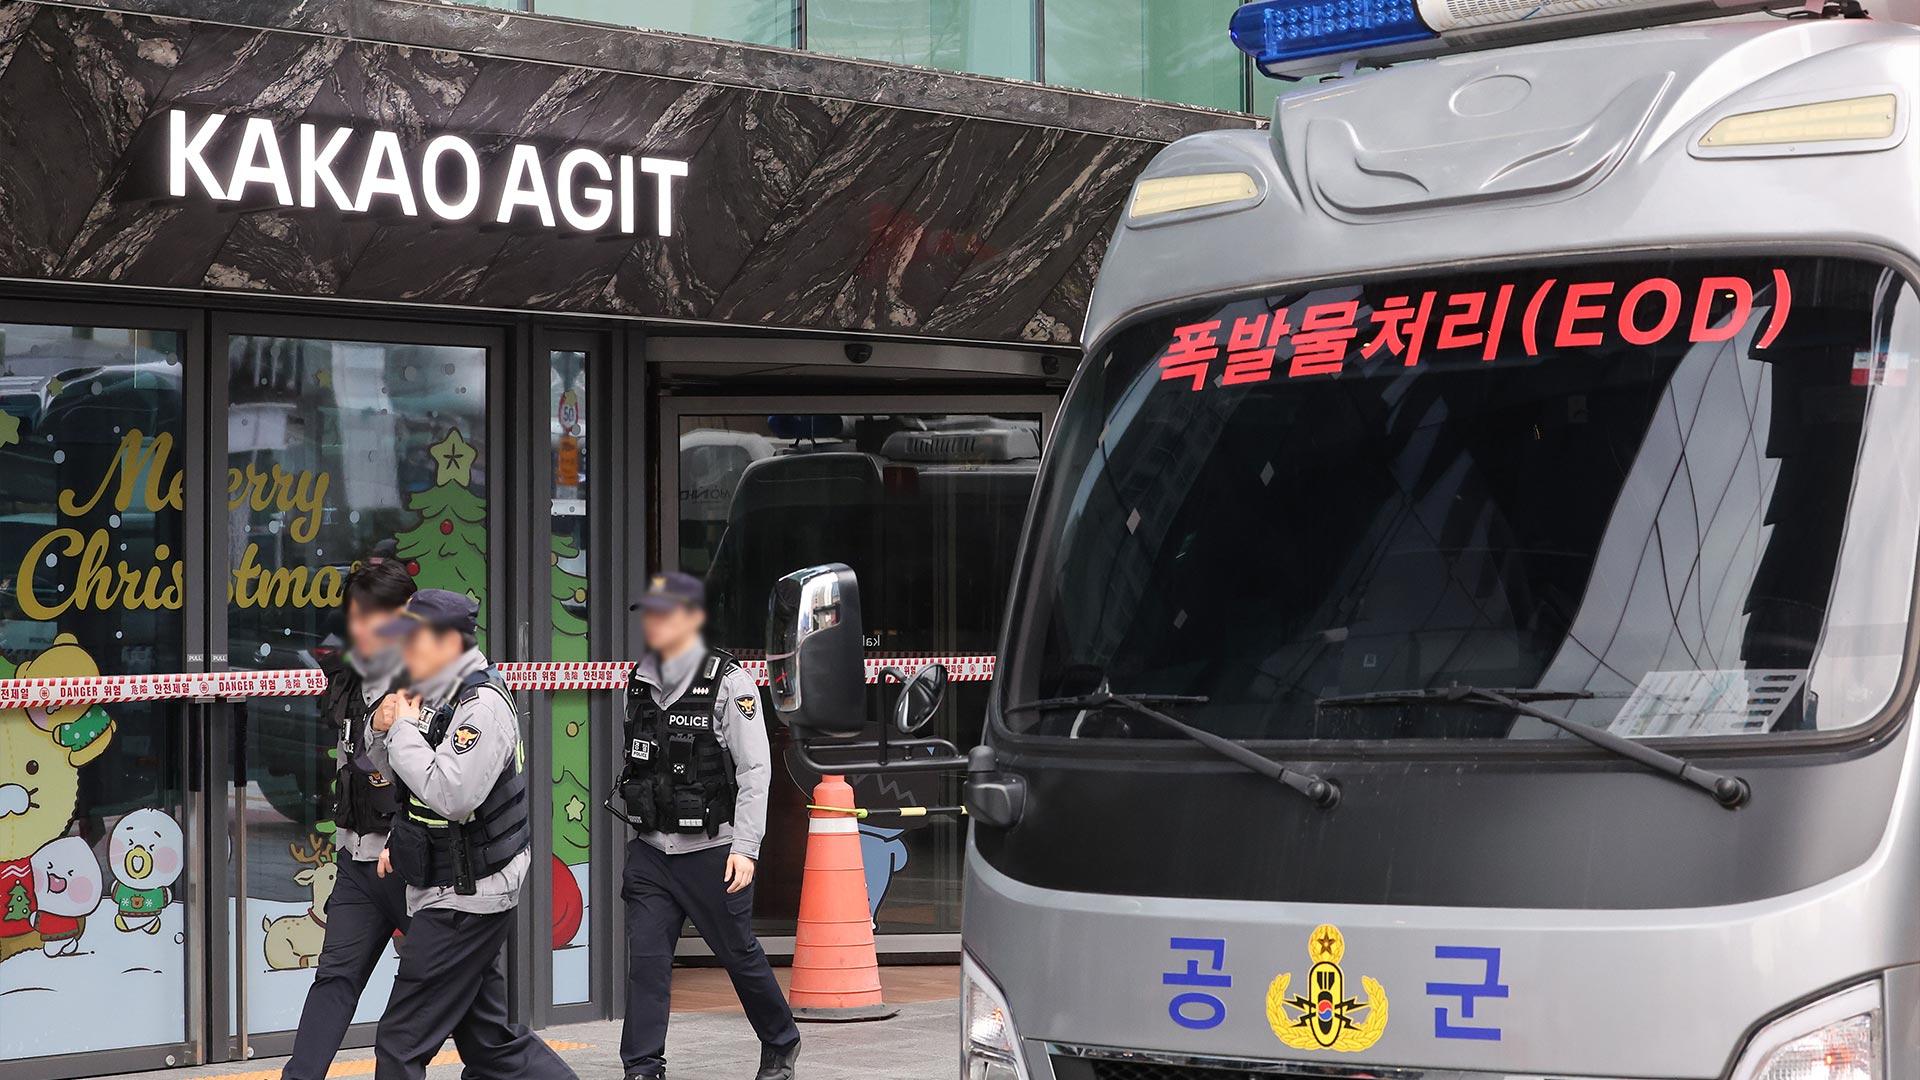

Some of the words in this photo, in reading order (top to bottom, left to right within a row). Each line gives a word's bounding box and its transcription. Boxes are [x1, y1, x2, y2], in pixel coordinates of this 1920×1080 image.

[169, 110, 481, 220] KAKAO
[496, 143, 689, 237] AGIT
[1158, 268, 1792, 392] 폭발물처리(EOD)
[58, 428, 330, 543] Merry
[16, 528, 361, 620] Christma
[60, 687, 98, 698] DANGER
[103, 685, 121, 696] 위험
[154, 682, 190, 695] 안전제일
[219, 680, 254, 691] DANGER
[259, 679, 277, 690] 위험
[506, 671, 537, 681] DANGER
[542, 671, 557, 681] 위험
[584, 670, 613, 681] 안전제일
[669, 714, 709, 727] POLICE
[1162, 936, 1232, 1030] 공
[1425, 945, 1509, 1041] 군
